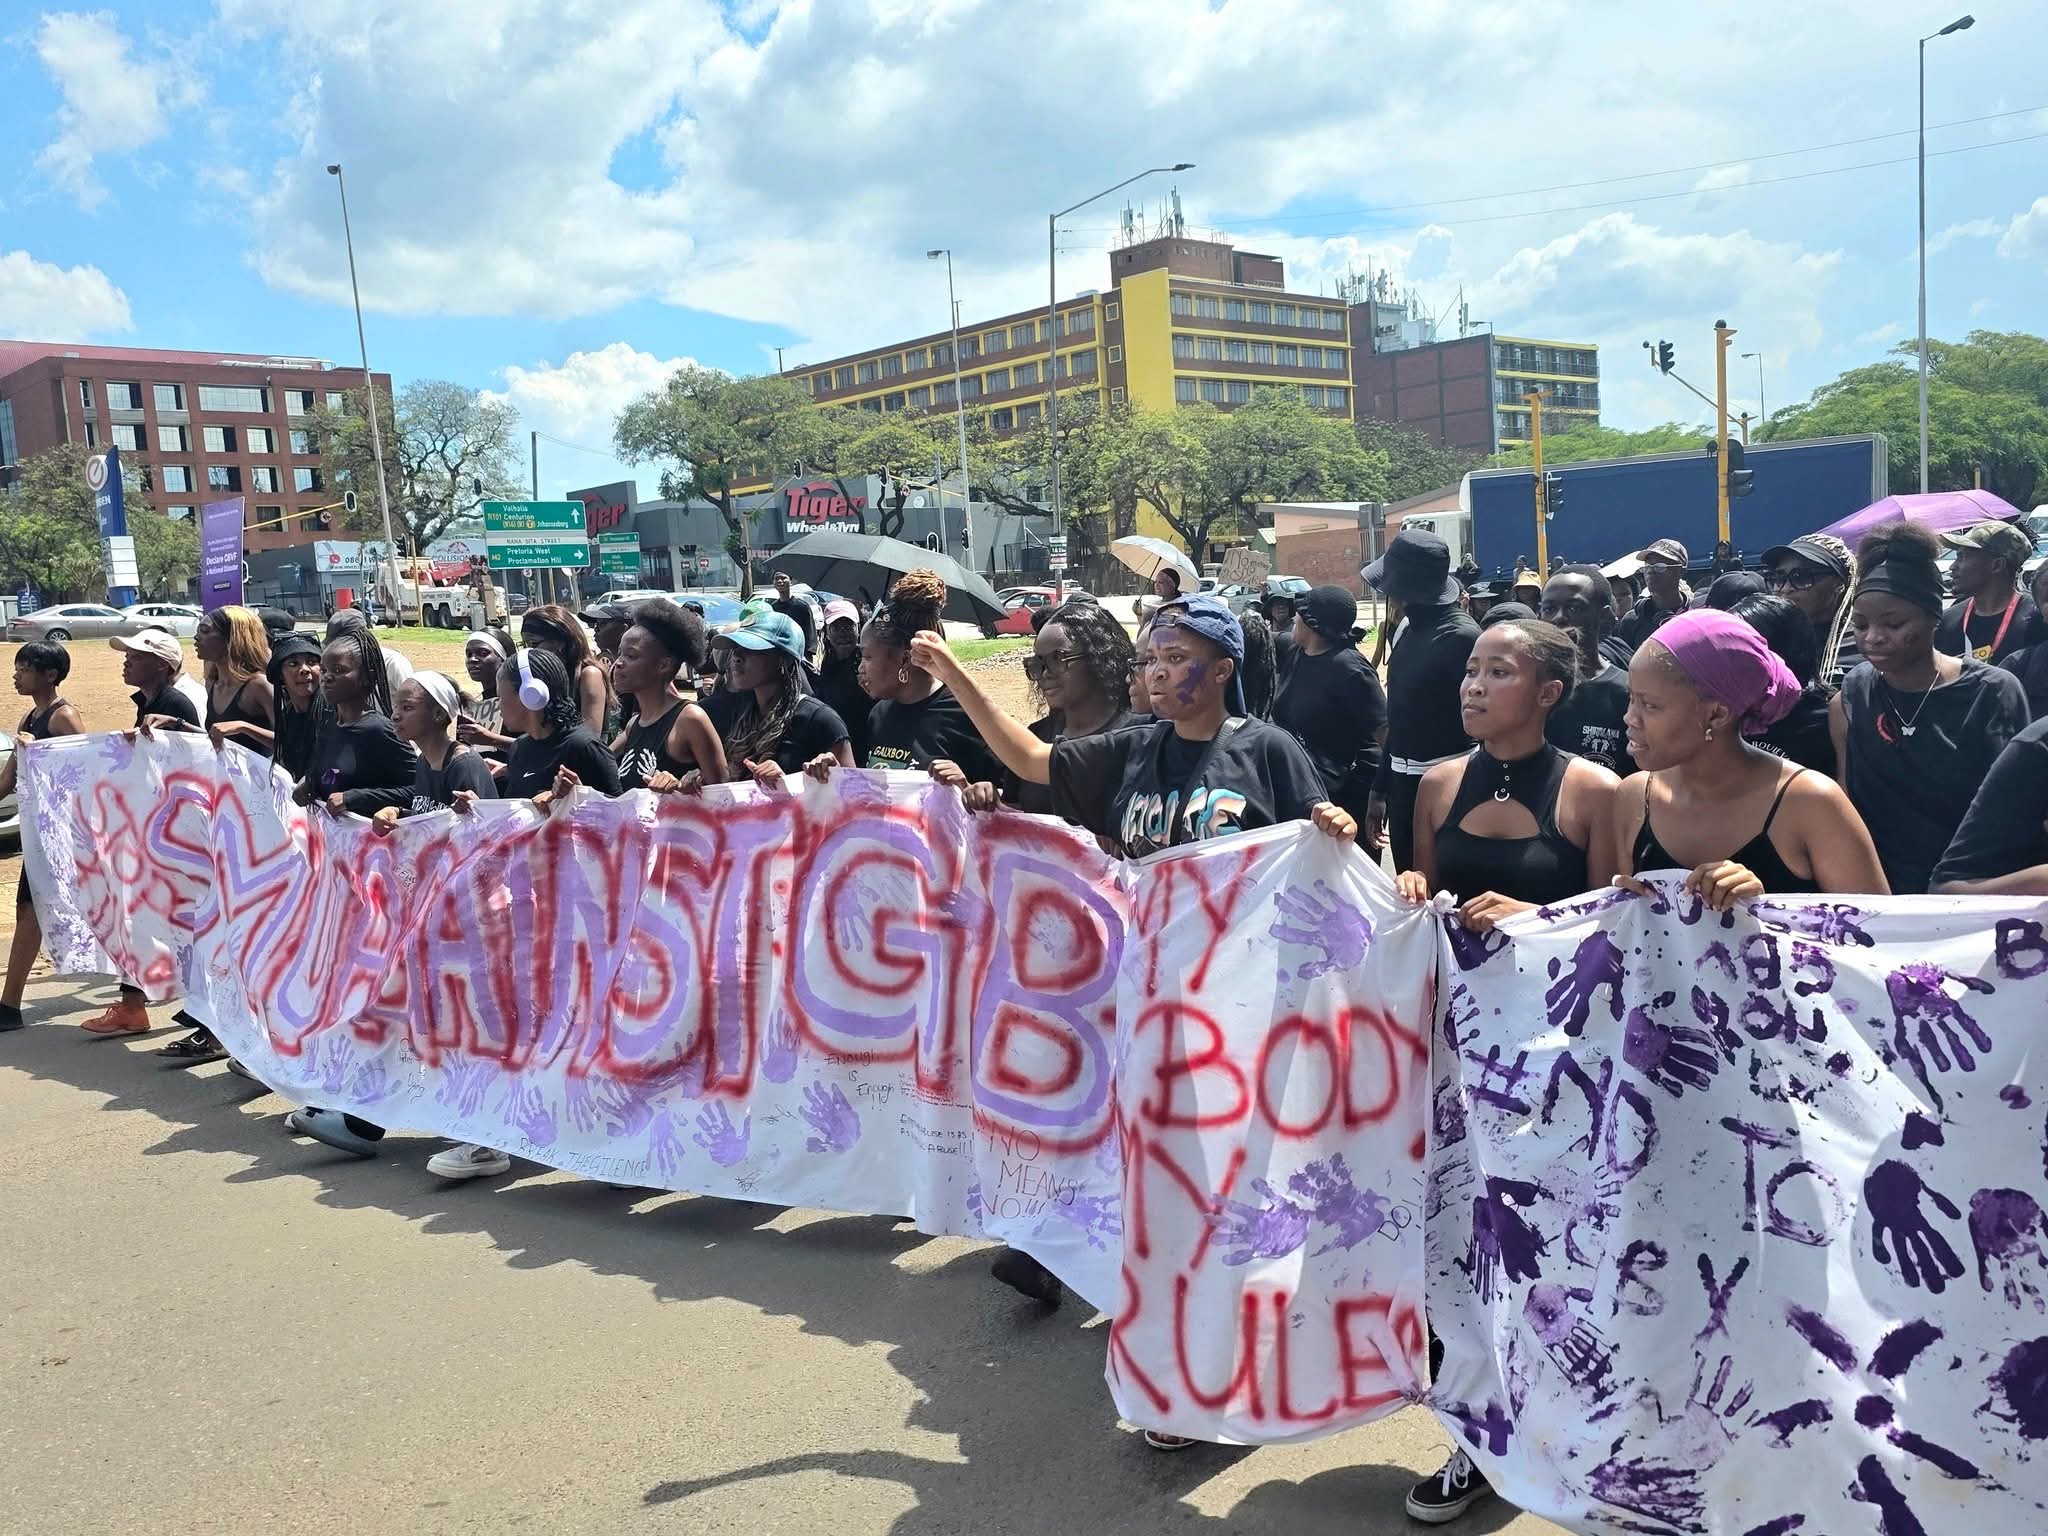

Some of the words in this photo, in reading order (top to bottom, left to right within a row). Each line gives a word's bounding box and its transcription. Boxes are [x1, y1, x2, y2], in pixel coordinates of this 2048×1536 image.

[786, 483, 867, 524] Tiger
[537, 520, 569, 529] Johannesburg
[586, 503, 626, 536] ger
[206, 555, 224, 566] Declare
[507, 547, 533, 556] Pretoria
[535, 547, 551, 555] West
[508, 557, 550, 566] Proclamation
[551, 556, 562, 564] Hill
[990, 1123, 1041, 1162] NO
[998, 1160, 1079, 1206] MEANS
